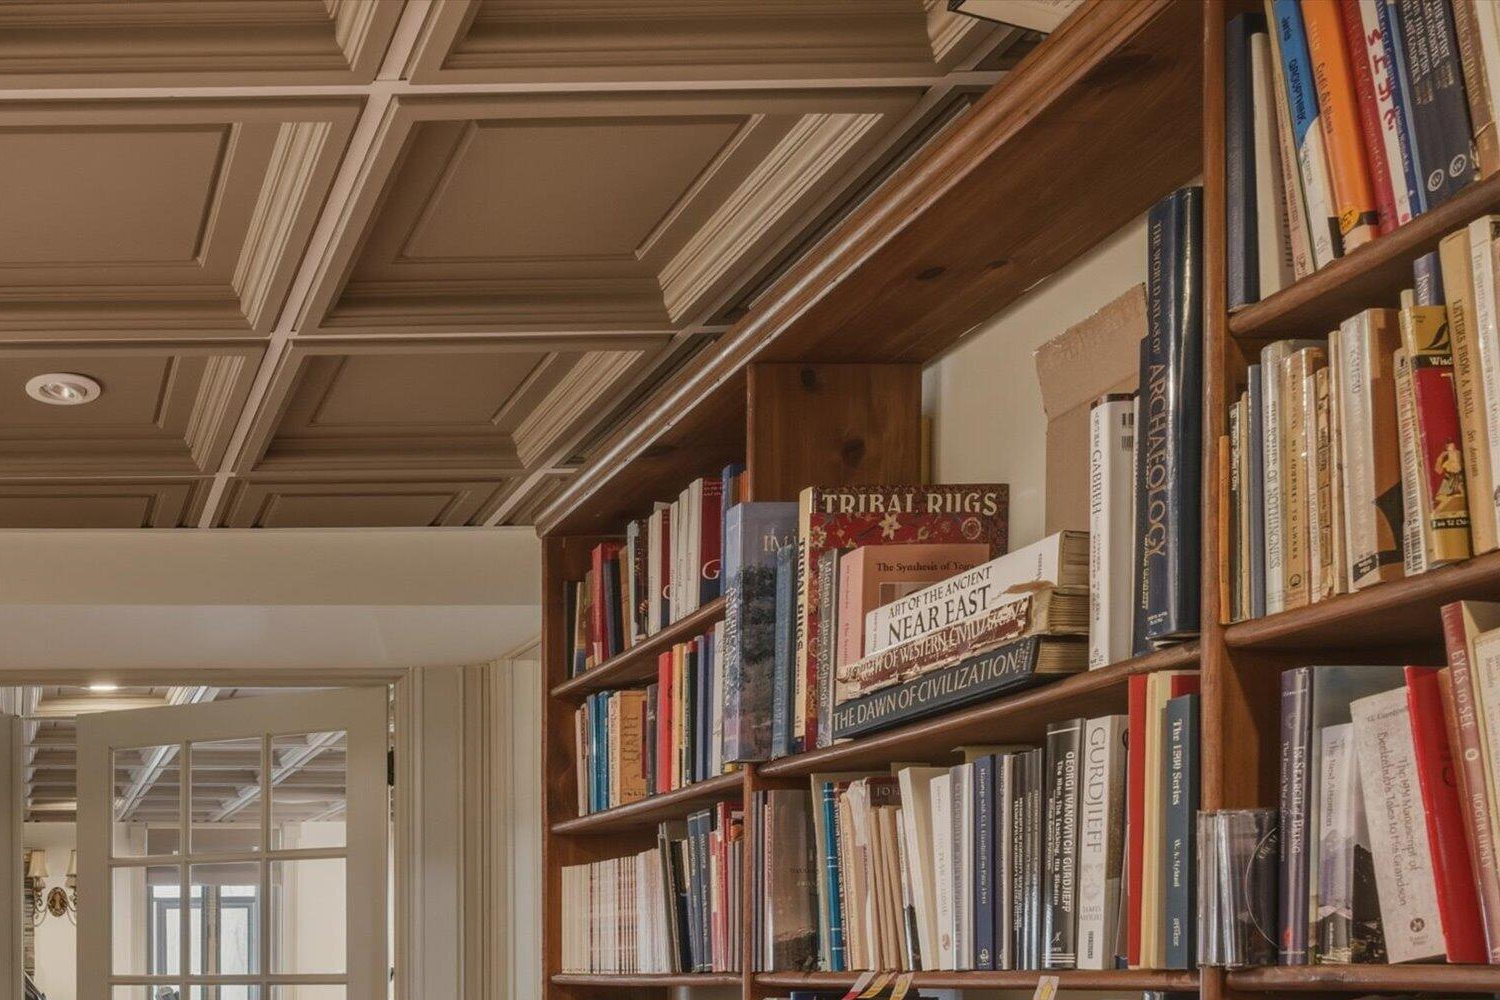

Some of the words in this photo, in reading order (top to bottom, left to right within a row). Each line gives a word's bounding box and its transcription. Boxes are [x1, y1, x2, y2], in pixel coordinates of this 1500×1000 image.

[1151, 222, 1161, 244] THE
[1152, 250, 1162, 296] WORLD
[1152, 300, 1161, 336] ATLAS
[1451, 298, 1466, 342] LETTERS
[1456, 345, 1469, 375] FROM
[1460, 378, 1471, 388] A
[1461, 389, 1474, 418] BAUL
[1146, 363, 1167, 556] ARCHAEOLOGY
[1266, 470, 1277, 482] OF
[822, 493, 919, 514] TRIBAL
[927, 492, 998, 516] RUGS
[796, 537, 805, 595] TRIBAL
[876, 563, 894, 572] The
[940, 562, 949, 571] of
[888, 602, 908, 620] ART
[909, 594, 925, 612] OF
[922, 586, 944, 605] THE
[944, 566, 993, 599] ANCIENT
[795, 603, 804, 651] RUGS
[888, 608, 940, 646] NEAR
[945, 584, 991, 625] EAST
[1450, 649, 1469, 684] EYES
[832, 710, 856, 732] THE
[857, 695, 896, 725] DAWN
[898, 689, 917, 709] OF
[916, 649, 1018, 702] CIVILIZATION
[1172, 718, 1183, 740] The
[1457, 705, 1474, 730] SEE
[1064, 751, 1074, 790] GEORGI
[1397, 758, 1410, 777] The
[1084, 726, 1106, 853] GURDJIEFF
[1171, 772, 1182, 806] Series
[1384, 793, 1398, 820] Tales
[1063, 794, 1074, 854] IVANOVITCH
[1388, 821, 1399, 834] to
[1399, 799, 1418, 857] Manuscript
[1471, 792, 1488, 833] ROGER
[1408, 859, 1420, 871] of
[1477, 833, 1494, 869] LIPSEY
[1061, 857, 1072, 913] GURDJIEFF
[1391, 853, 1411, 907] Grandson
